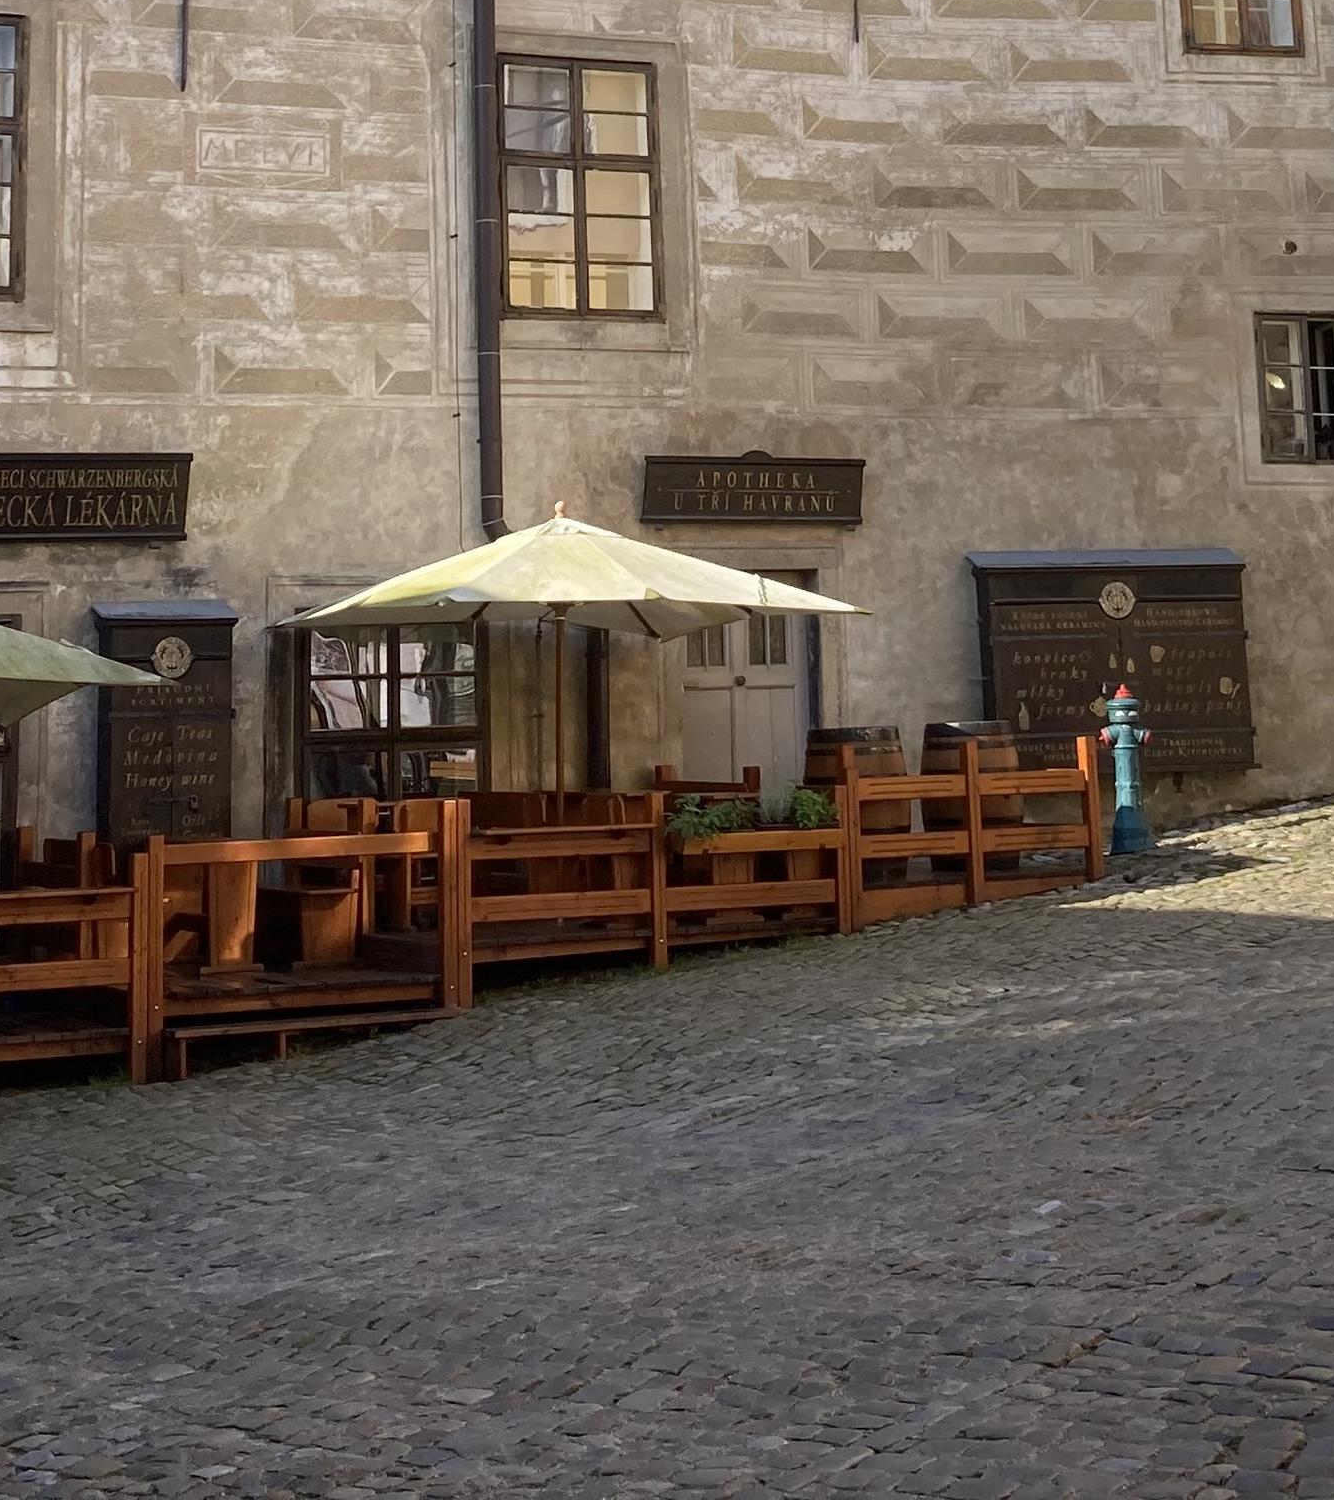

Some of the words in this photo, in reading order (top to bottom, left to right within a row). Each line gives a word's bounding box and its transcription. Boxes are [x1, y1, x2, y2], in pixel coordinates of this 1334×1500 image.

[695, 470, 817, 490] APOTHEKA
[673, 492, 684, 511] U
[123, 749, 218, 766] Medovina
[124, 772, 173, 791] Honey
[181, 773, 216, 786] wine
